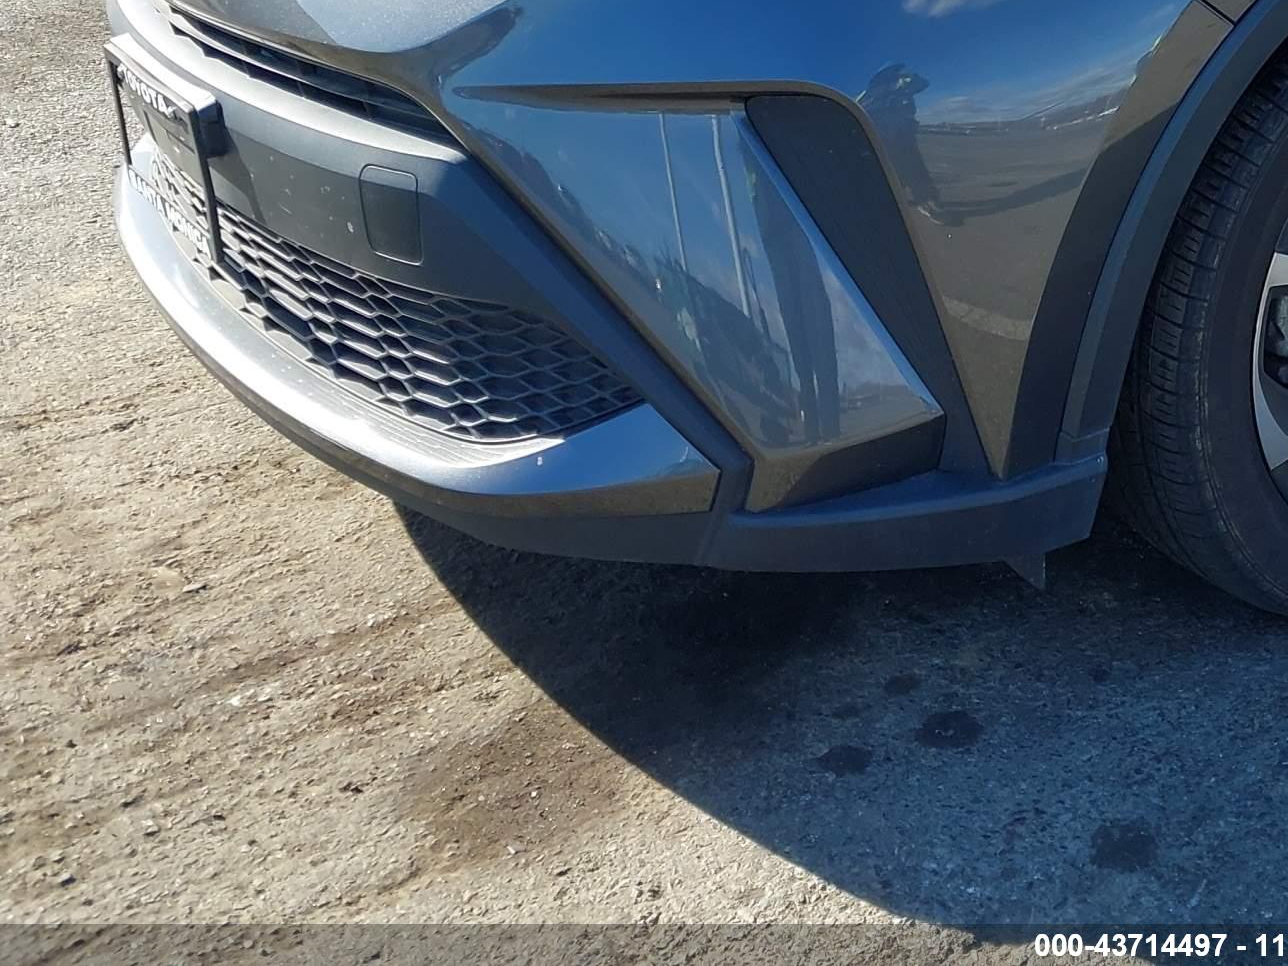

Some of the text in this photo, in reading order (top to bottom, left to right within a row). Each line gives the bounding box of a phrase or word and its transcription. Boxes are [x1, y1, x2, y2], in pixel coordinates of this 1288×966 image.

[118, 63, 169, 117] TOYOTA
[128, 168, 212, 260] SANTA MONICA
